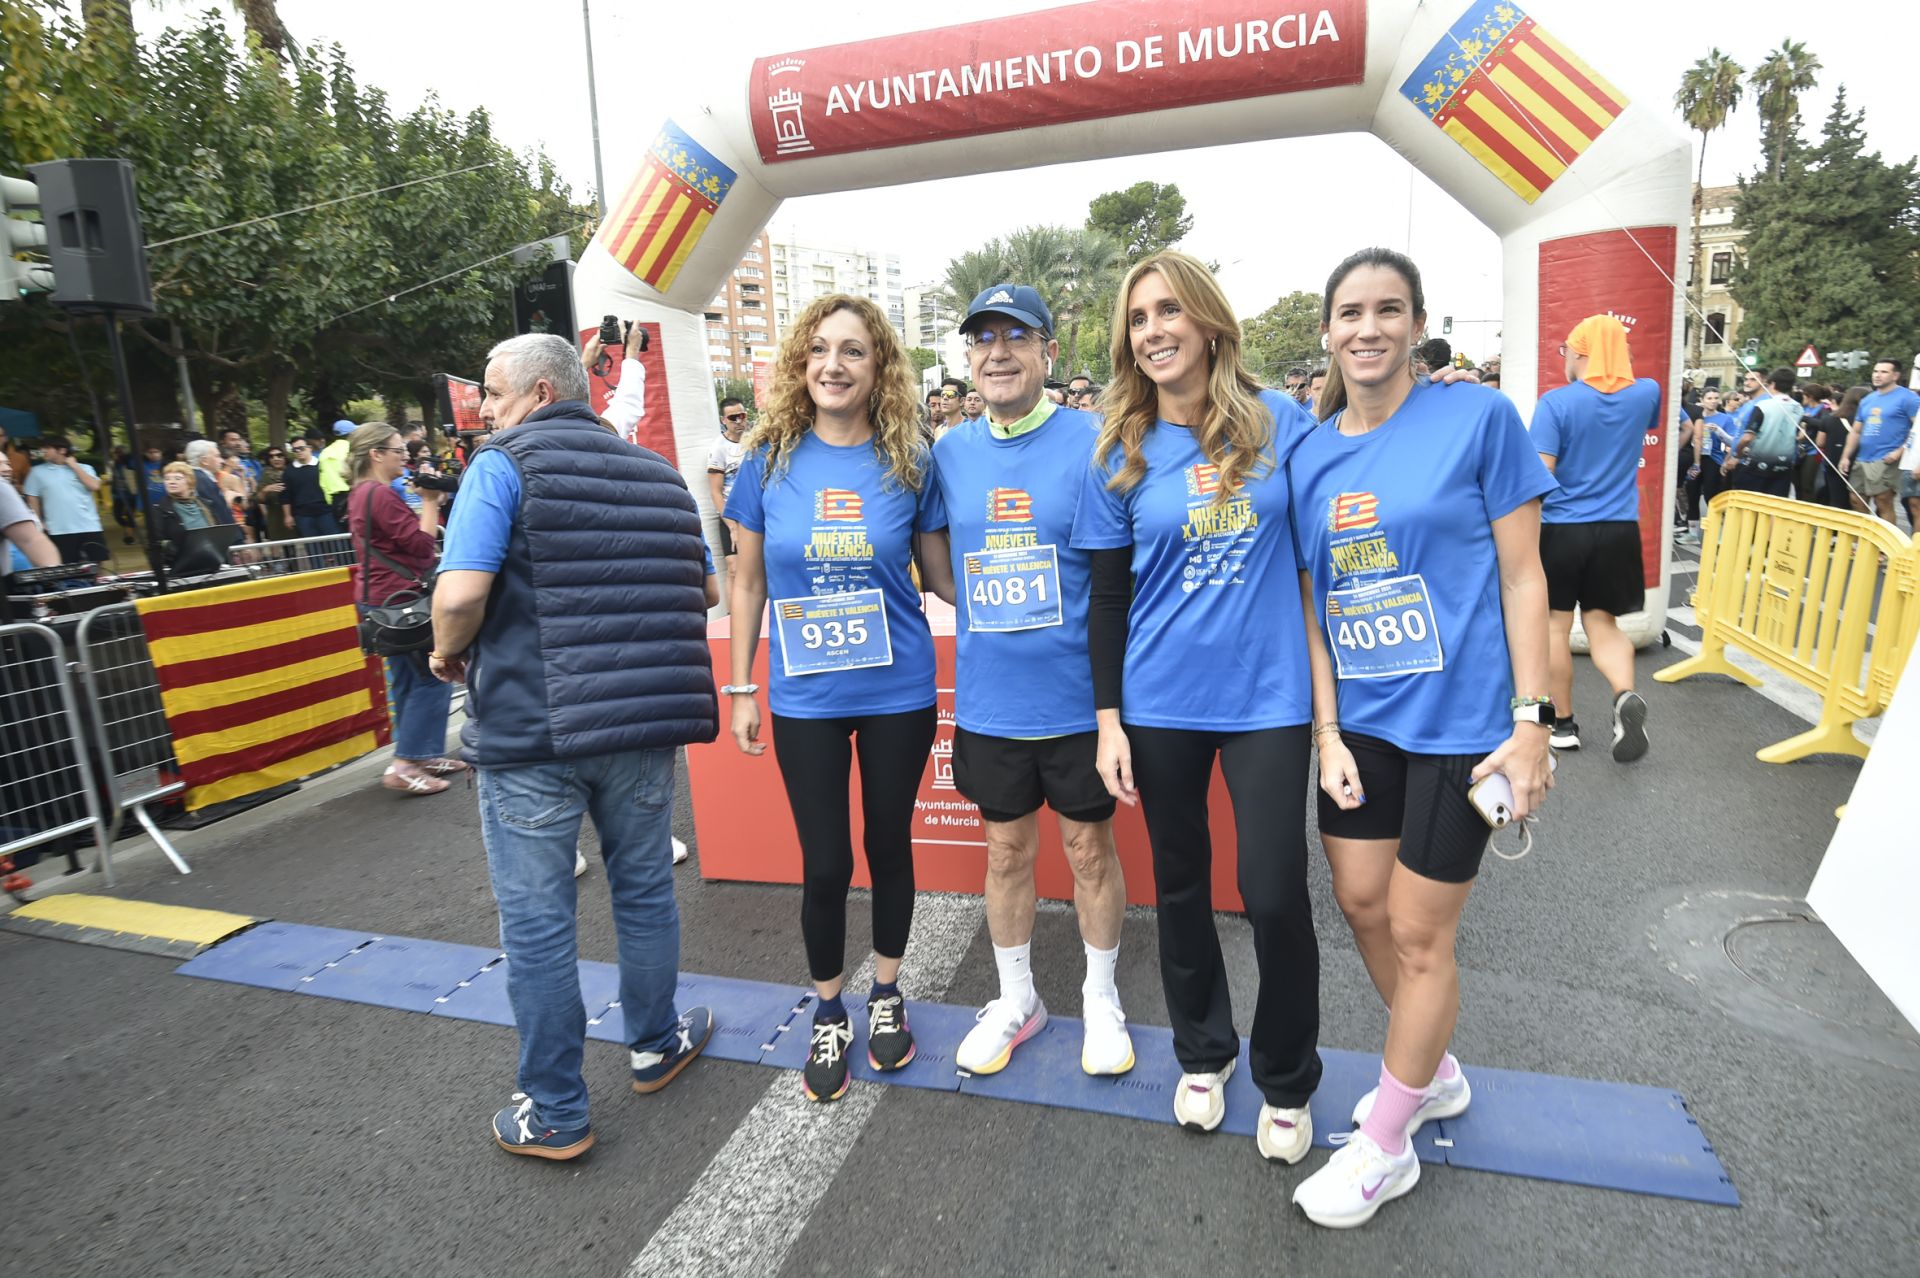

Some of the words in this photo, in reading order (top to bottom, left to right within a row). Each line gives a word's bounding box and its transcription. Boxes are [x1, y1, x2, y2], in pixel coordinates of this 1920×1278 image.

[825, 46, 1102, 117] AYUNTAMIENTO
[1115, 35, 1164, 73] DE
[1178, 10, 1340, 64] MURCIA
[1181, 523, 1192, 539] X
[1195, 513, 1258, 537] VALENCIA
[811, 529, 867, 545] MUÉVETE
[985, 530, 1038, 549] MUÉVETE
[804, 545, 813, 558] X
[815, 543, 874, 557] VALENCIA
[1330, 537, 1387, 560] MUÉVETE
[1010, 563, 1016, 573] X
[1017, 560, 1052, 573] VALENCIA
[1329, 562, 1339, 577] X
[1337, 551, 1399, 573] VALENCIA
[972, 574, 1047, 607] 4081
[1375, 601, 1383, 611] X
[1382, 592, 1424, 609] VALENCIA
[801, 618, 868, 649] 935
[1338, 608, 1428, 650] 4080
[914, 799, 979, 811] Ayuntamien
[924, 815, 938, 825] de
[941, 815, 980, 827] Murcia
